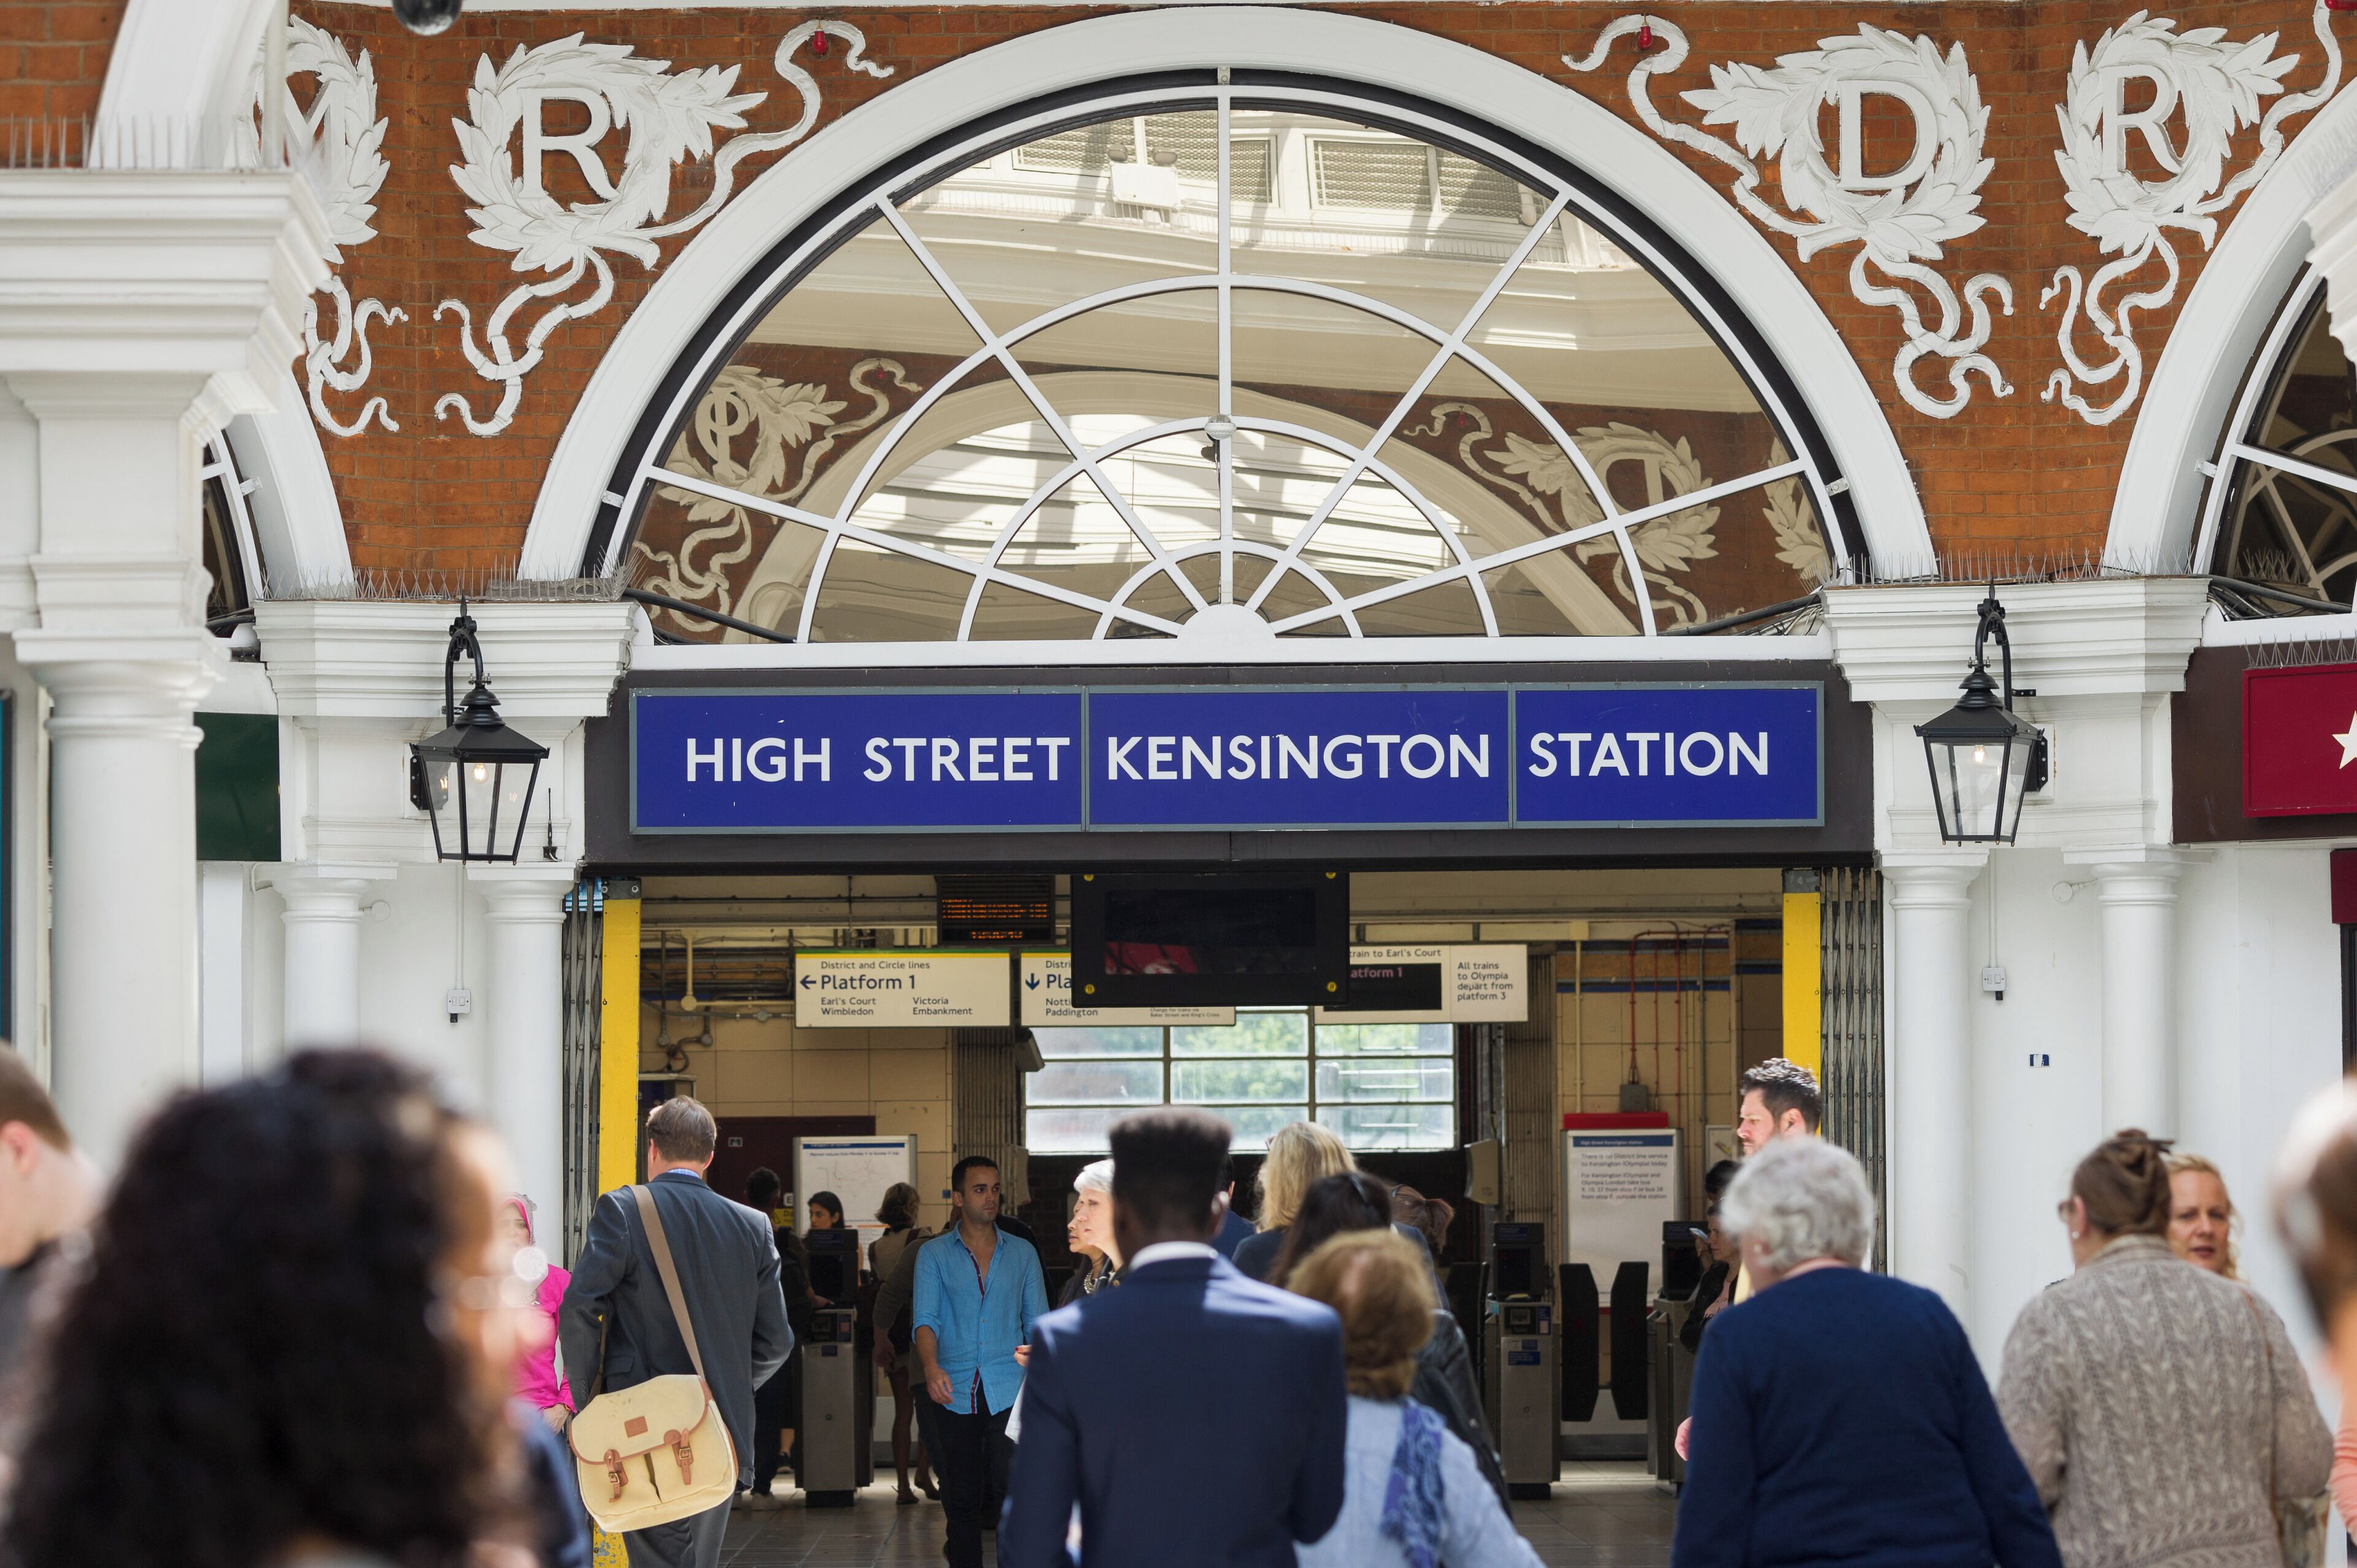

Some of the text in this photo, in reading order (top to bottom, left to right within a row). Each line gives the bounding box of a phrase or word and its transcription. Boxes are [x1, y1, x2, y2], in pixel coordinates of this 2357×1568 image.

[2099, 64, 2185, 180] R
[1837, 79, 1938, 191] D
[517, 87, 619, 201] R
[687, 732, 1768, 782] HIGH STREET KENSINGTON STATION
[1350, 967, 1404, 978] atform 1
[1471, 972, 1508, 982] Olympia
[821, 975, 915, 990] Platform 1
[1457, 983, 1488, 992] depart
[821, 997, 877, 1006] Earl's Court
[913, 997, 949, 1005] Victoria
[1457, 992, 1498, 1002] platform
[821, 1007, 874, 1016] Wimbledon
[1046, 1008, 1099, 1018] Paddington
